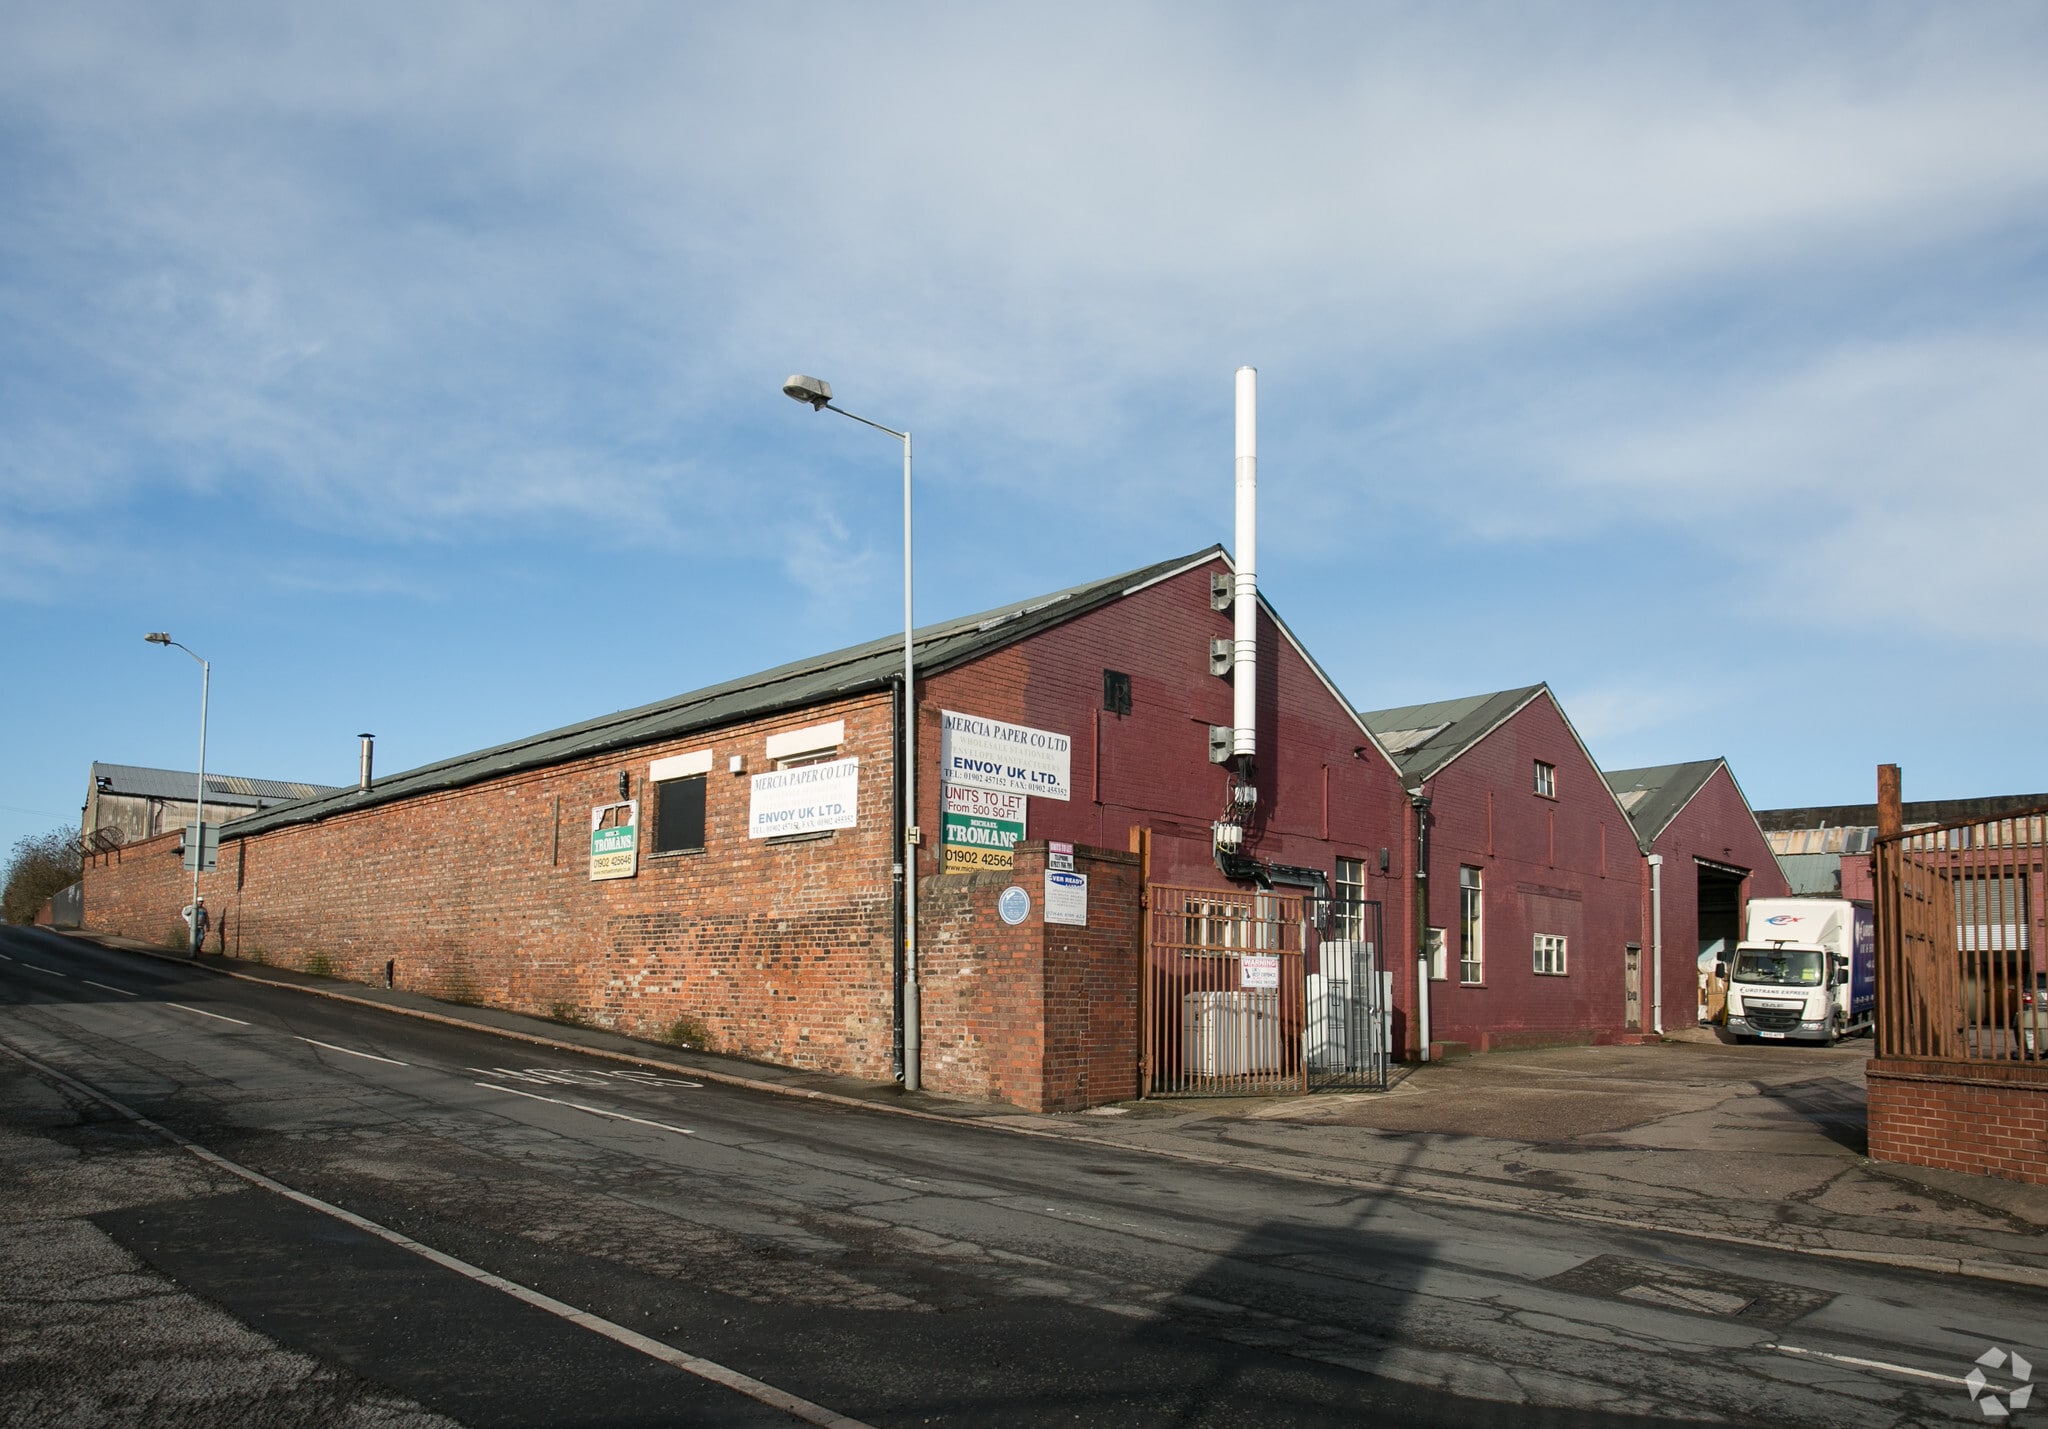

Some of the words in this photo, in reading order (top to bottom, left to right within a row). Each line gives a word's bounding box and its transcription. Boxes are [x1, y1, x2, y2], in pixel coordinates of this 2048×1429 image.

[944, 715, 991, 737] MERCIA
[994, 725, 1028, 745] PAPER
[1031, 733, 1046, 748] CO
[1048, 737, 1068, 752] LTD
[959, 736, 1008, 752] WHOLESALE
[1009, 745, 1055, 760] STATIONERS
[754, 775, 787, 791] MERCIA
[790, 769, 818, 785] PAPER
[820, 767, 834, 781] CO
[836, 763, 855, 777] LTD
[953, 756, 1002, 775] ENVOY
[1007, 766, 1026, 780] UK
[1031, 771, 1060, 786] LTD.
[944, 768, 962, 779] TEL:
[963, 772, 982, 782] 01902
[985, 776, 1007, 786] 457152
[1010, 781, 1027, 790] FAX:
[1028, 784, 1046, 793] 01902
[1047, 786, 1067, 796] 455352
[945, 786, 979, 803] UNITS
[983, 792, 998, 806] TO
[1002, 795, 1022, 809] LET
[758, 809, 795, 824] ENVOY
[798, 807, 814, 819] UK
[819, 804, 845, 816] LTD.
[948, 801, 970, 813] From
[973, 804, 990, 816] 500
[971, 819, 998, 829] MICHAEL
[594, 835, 632, 853] TROMANS
[908, 828, 917, 842] H
[946, 824, 1018, 848] TROMANS
[593, 857, 610, 868] 01902
[611, 854, 632, 867] 425646
[945, 849, 978, 864] 01902
[981, 853, 1013, 867] 42564
[1065, 876, 1083, 885] READY
[1244, 958, 1276, 967] WARNING
